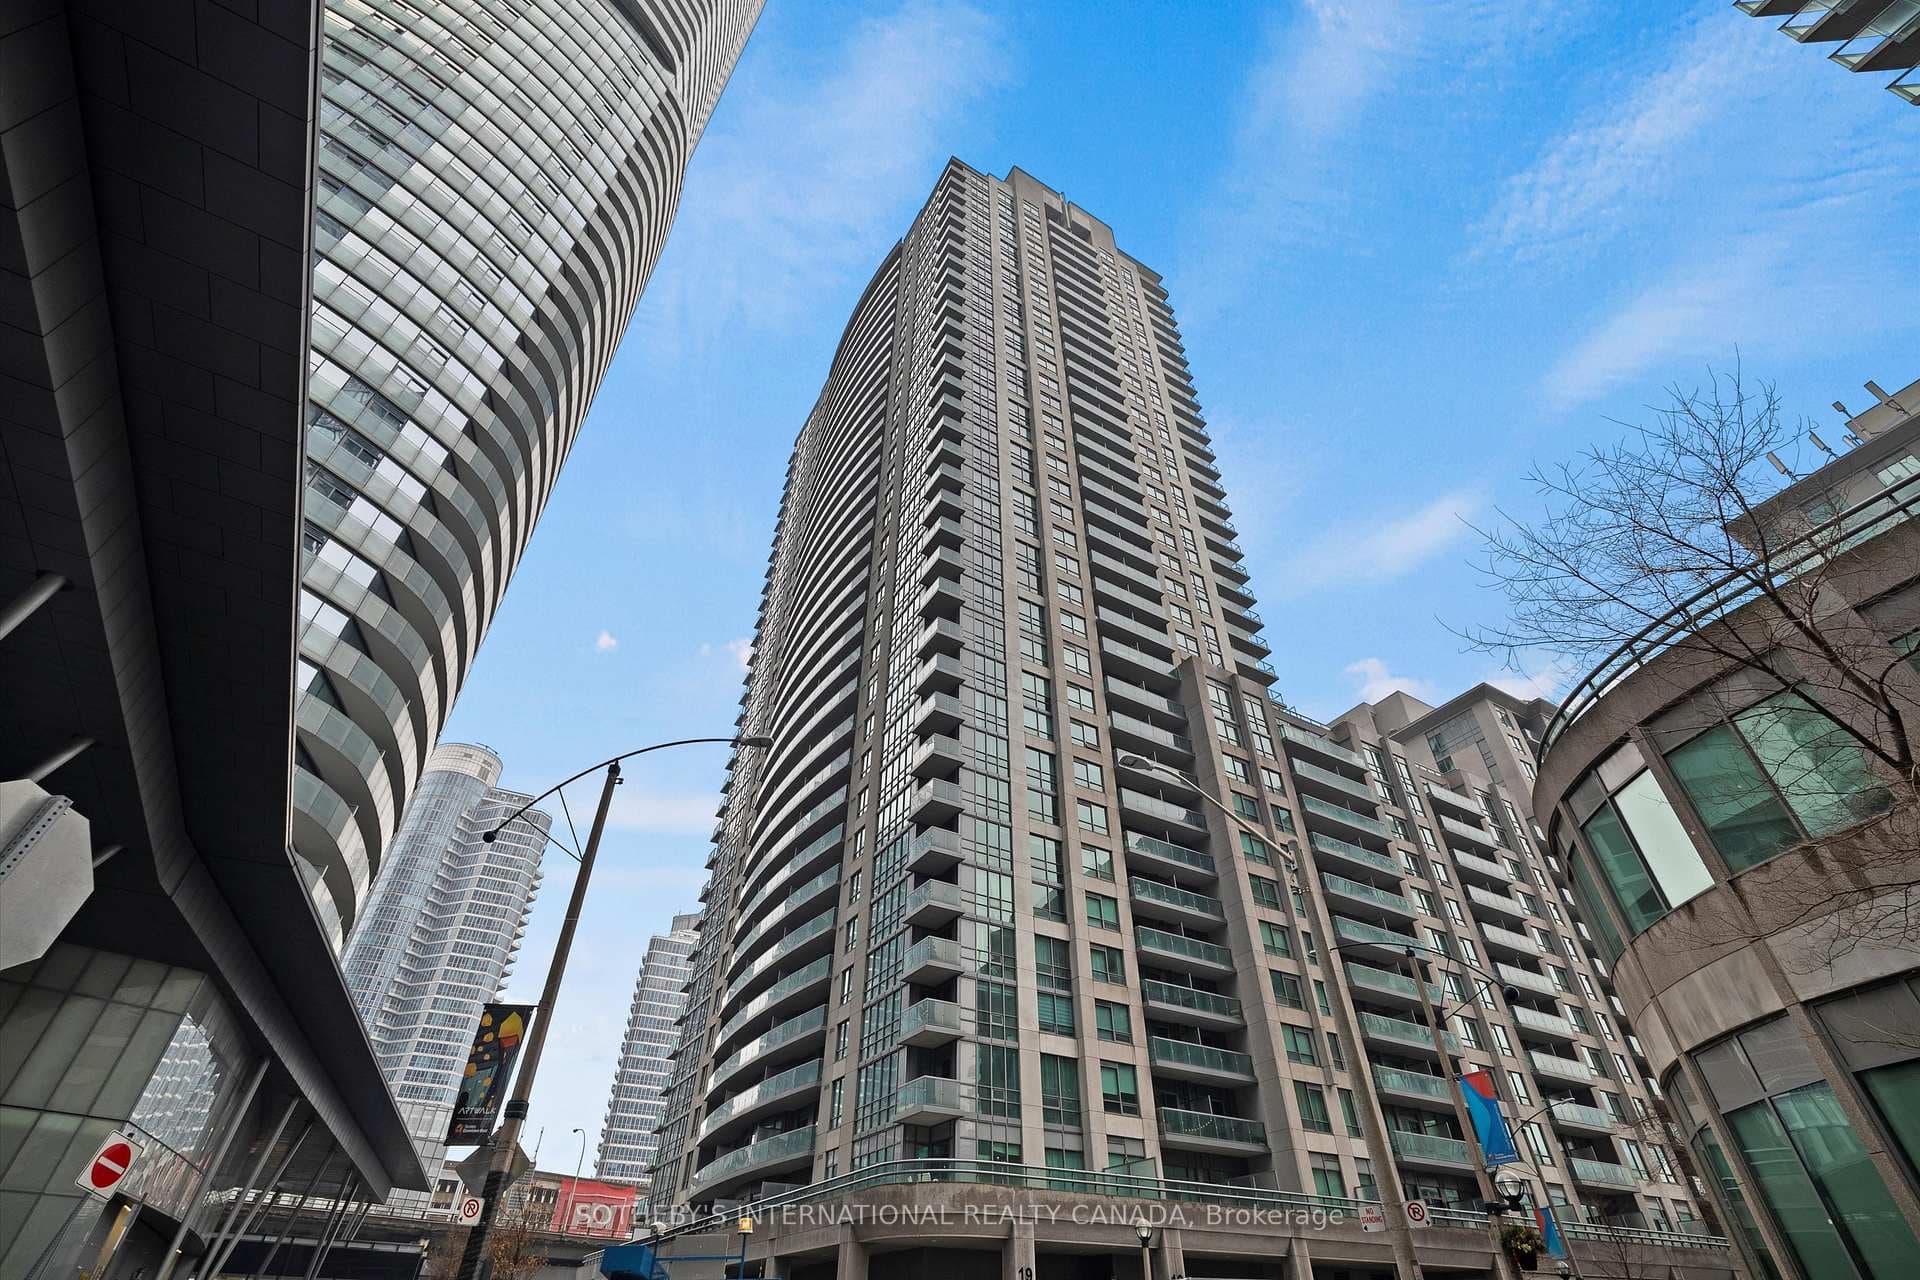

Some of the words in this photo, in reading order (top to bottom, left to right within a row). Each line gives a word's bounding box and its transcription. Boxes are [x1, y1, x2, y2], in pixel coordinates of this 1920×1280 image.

[1365, 1207, 1374, 1215] NO
[1361, 1215, 1383, 1224] STANDING
[1018, 1266, 1033, 1280] 19
